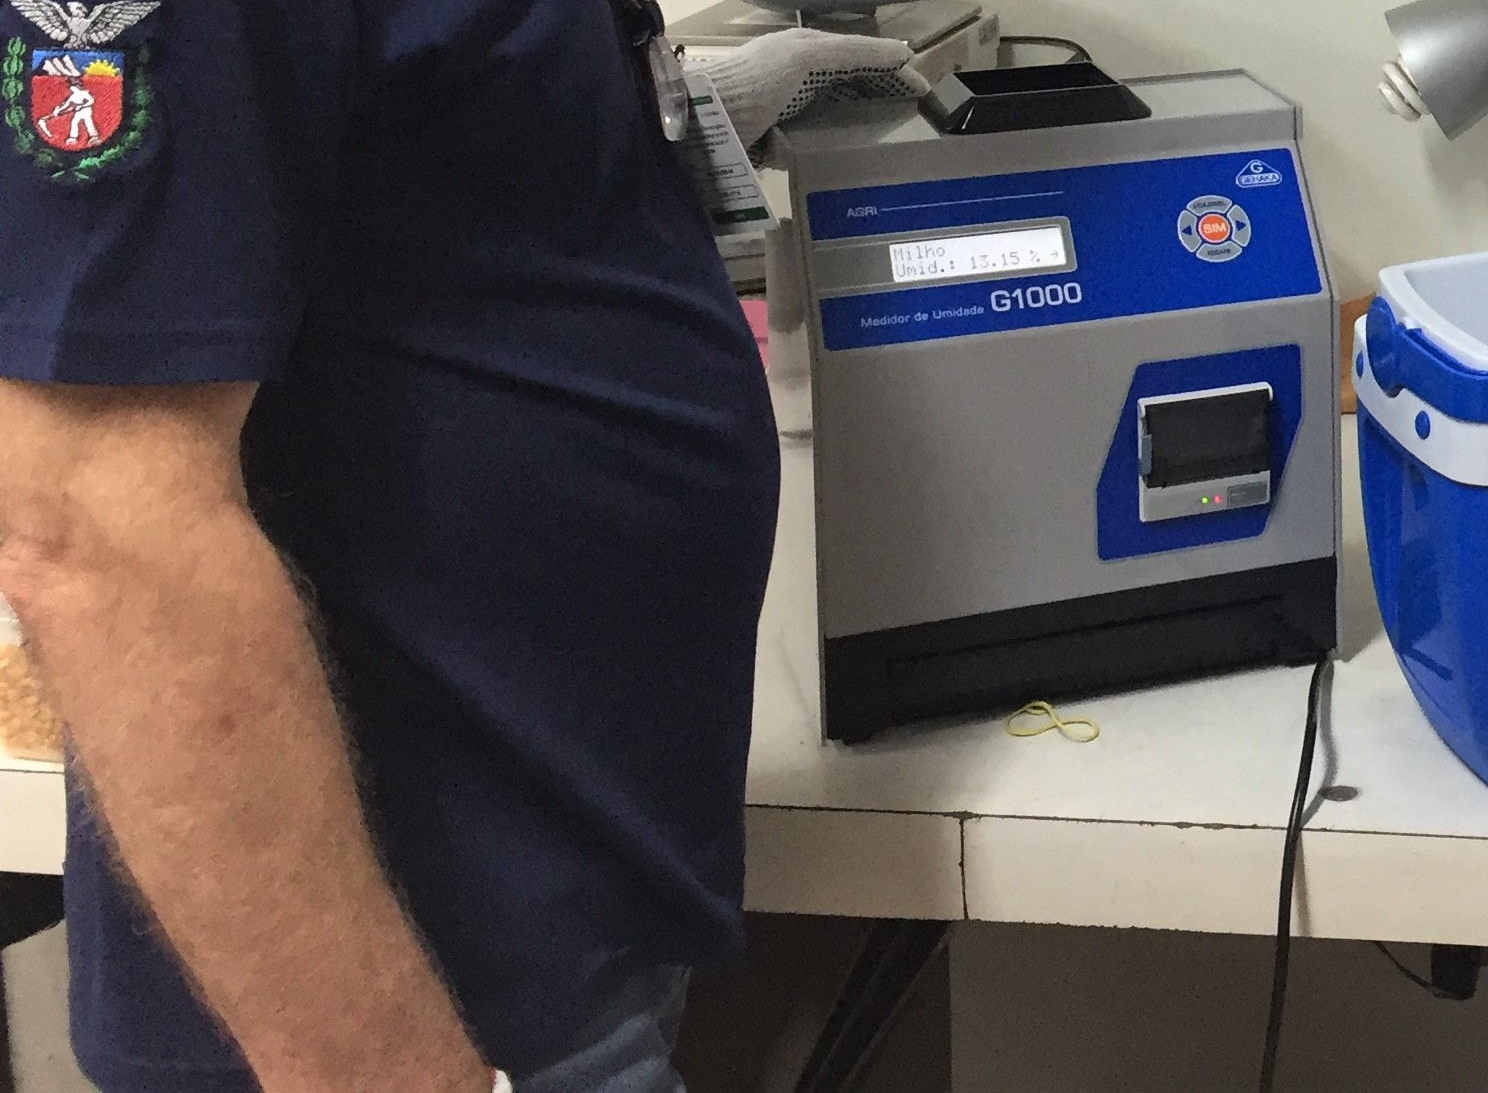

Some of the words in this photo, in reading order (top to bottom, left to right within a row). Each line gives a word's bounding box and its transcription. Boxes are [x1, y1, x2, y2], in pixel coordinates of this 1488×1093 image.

[1250, 162, 1263, 173] G
[846, 206, 878, 218] AGRI
[1203, 223, 1226, 234] SIM
[893, 246, 946, 262] Milho
[970, 251, 1020, 270] 13.15
[1029, 250, 1041, 263] %
[861, 314, 910, 328] Medidor
[914, 311, 929, 322] de
[933, 305, 984, 320] Umidade
[990, 282, 1082, 312] G1000
